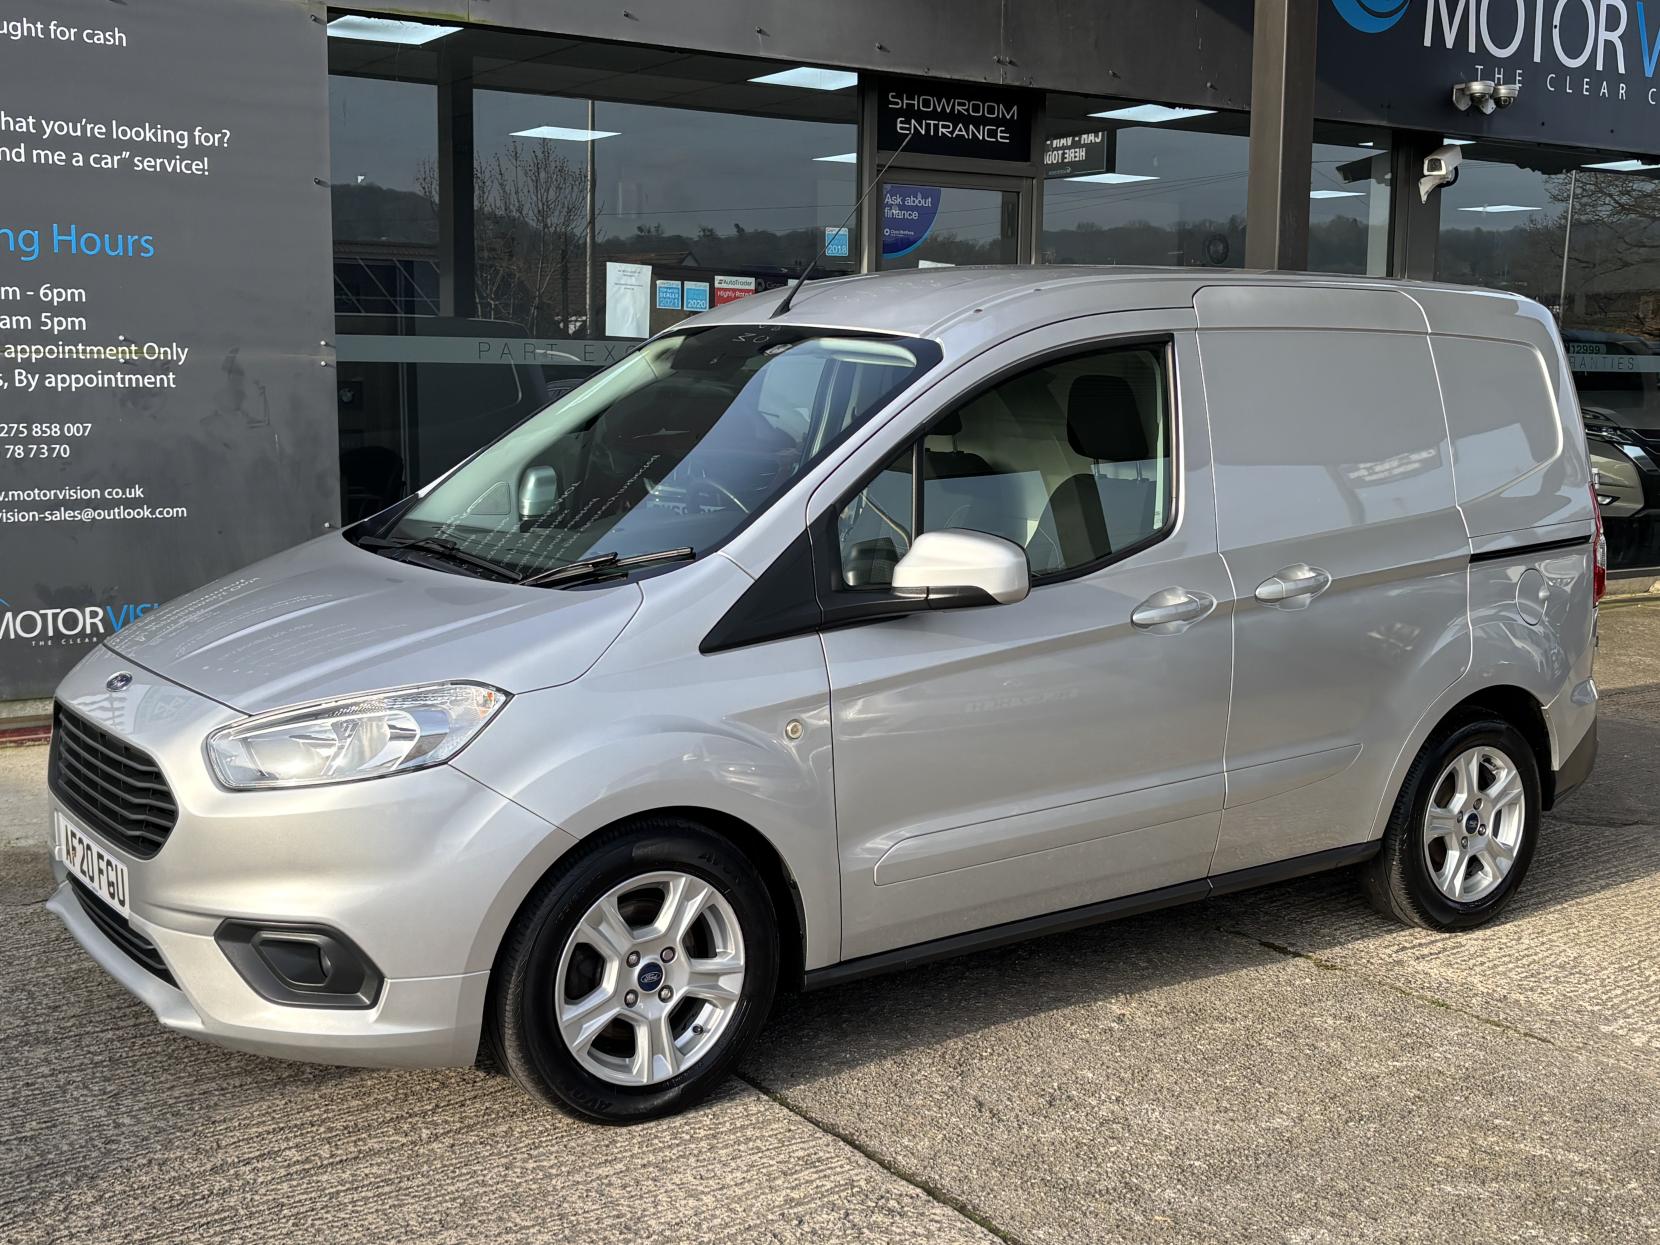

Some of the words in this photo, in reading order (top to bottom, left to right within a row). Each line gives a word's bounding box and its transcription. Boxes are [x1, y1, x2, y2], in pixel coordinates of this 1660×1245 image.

[0, 18, 44, 40] ught
[49, 21, 77, 41] for
[83, 28, 126, 46] cash
[1474, 65, 1523, 88] THE
[1546, 73, 1626, 100] CLEAR
[888, 92, 1018, 120] SHOWROOM
[1, 111, 36, 132] hat
[42, 119, 106, 138] you're
[113, 120, 188, 148] looking
[194, 127, 230, 147] for?
[897, 118, 1010, 143] ENTRANCE
[0, 143, 25, 162] nd
[33, 150, 66, 165] me
[72, 153, 83, 166] a
[90, 151, 130, 168] car"
[134, 155, 208, 175] service!
[884, 193, 903, 206] Ask
[904, 194, 931, 207] about
[884, 206, 919, 220] finance
[0, 229, 39, 261] ng
[53, 224, 154, 257] Hours
[723, 279, 753, 287] AutoTrader
[40, 284, 85, 306] 6pm
[688, 299, 706, 308] 2020
[717, 290, 735, 298] Highly
[0, 316, 31, 329] am
[41, 313, 86, 334] 5pm
[5, 341, 138, 362] appointment
[143, 343, 188, 365] Only
[479, 342, 561, 362] PART
[15, 369, 39, 391] By
[45, 370, 176, 391] appointment
[0, 424, 27, 437] 275
[32, 424, 60, 436] 858
[64, 424, 91, 436] 007
[5, 445, 24, 458] 78
[0, 505, 186, 522] ision-sales@outlook.com
[61, 637, 97, 645] CLEAR
[65, 824, 95, 884] AF20
[96, 850, 126, 908] FGU
